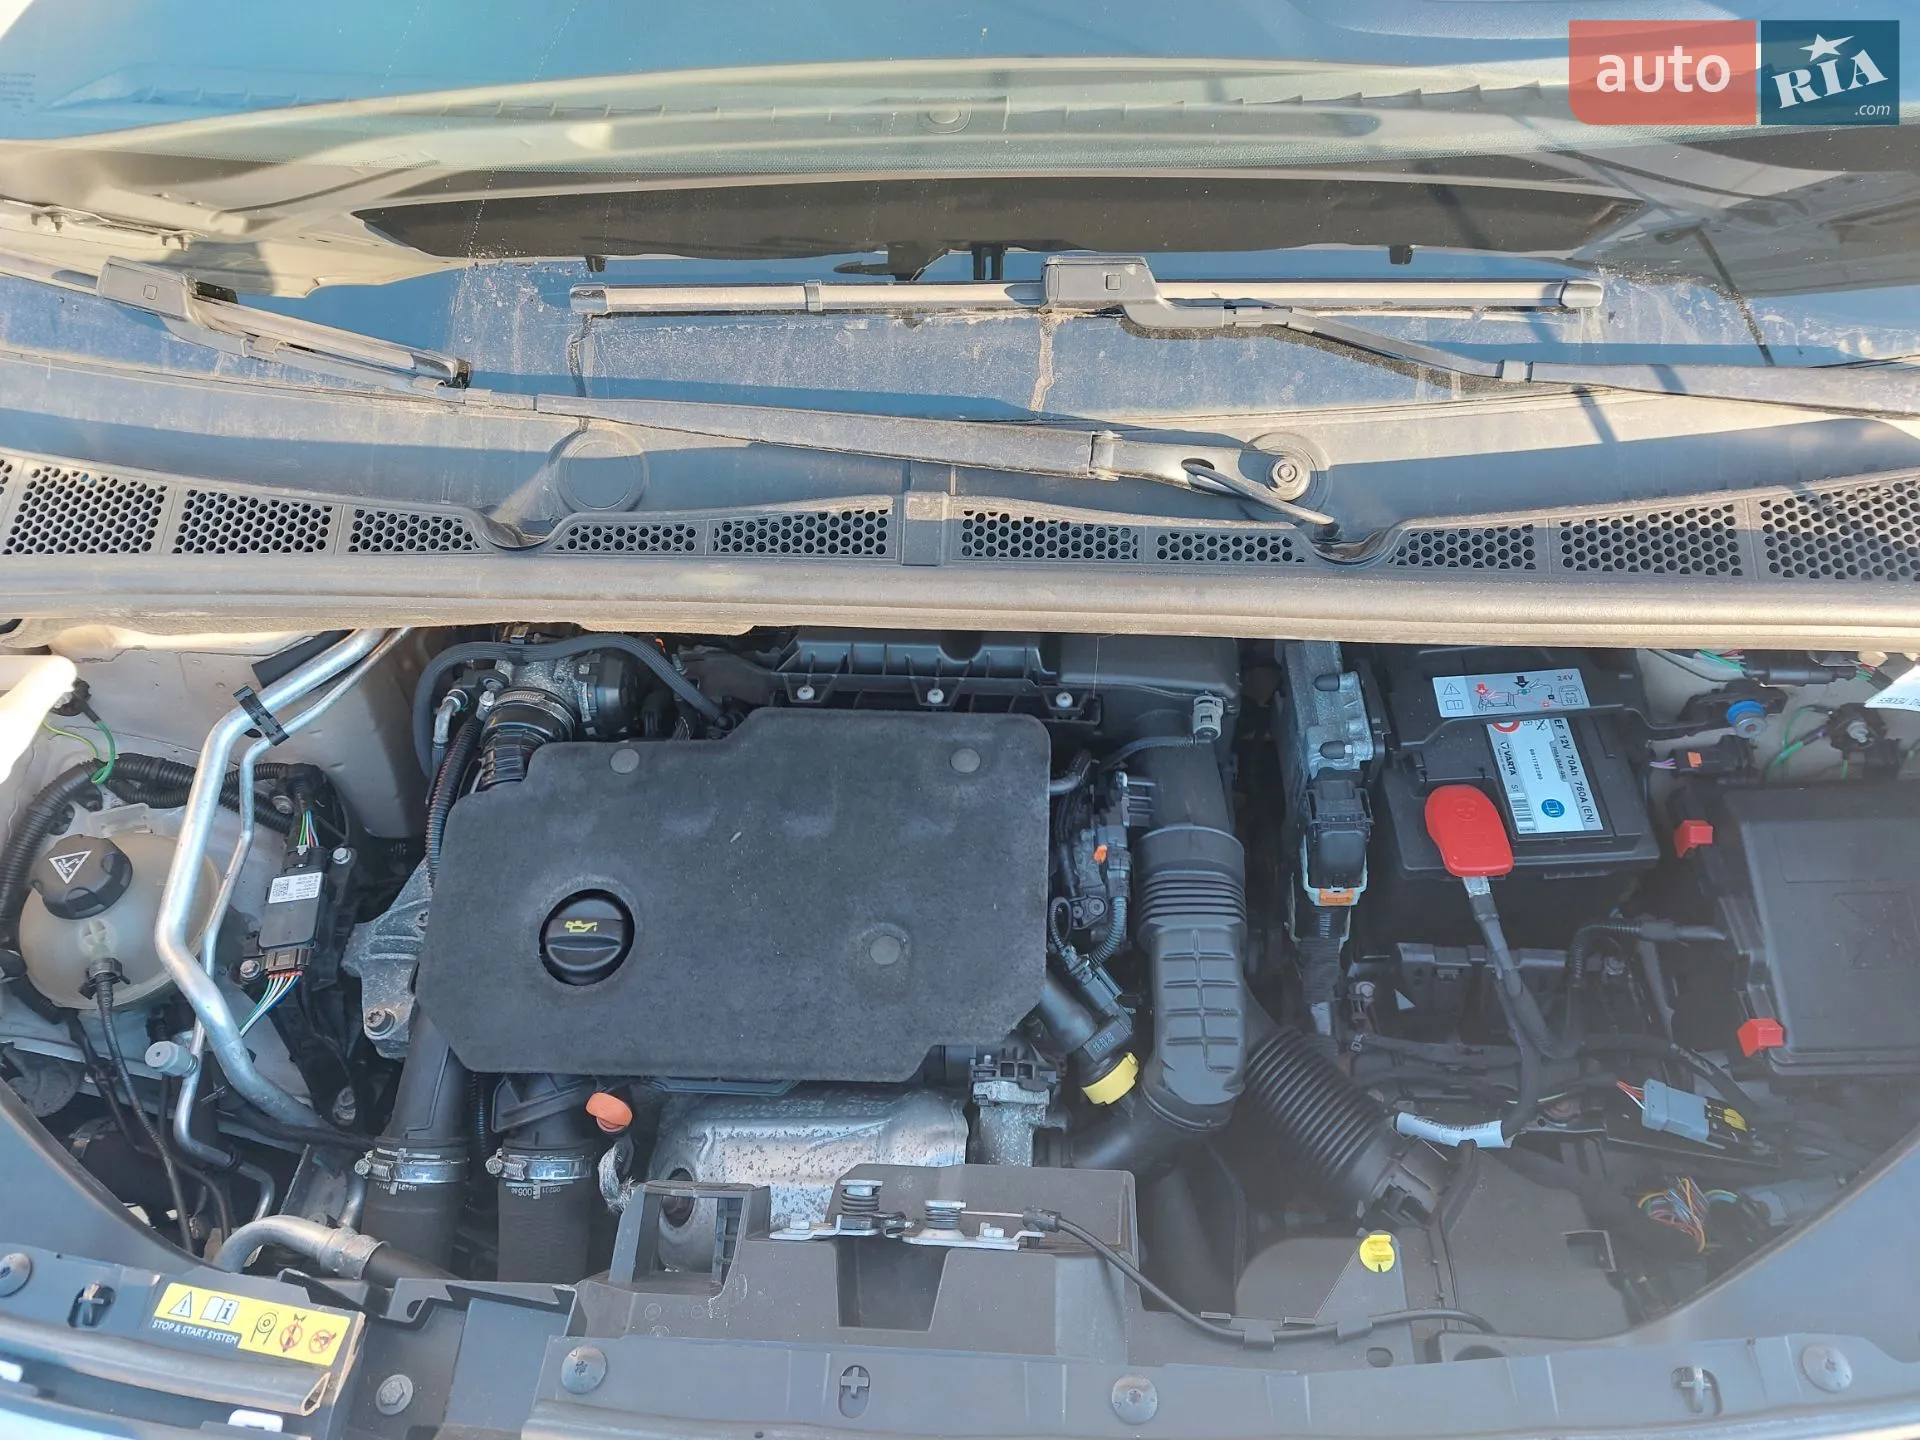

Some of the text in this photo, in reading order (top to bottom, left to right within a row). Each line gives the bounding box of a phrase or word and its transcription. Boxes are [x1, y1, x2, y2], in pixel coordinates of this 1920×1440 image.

[1557, 674, 1573, 682] 24V
[1503, 750, 1517, 776] VARTA
[1559, 735, 1572, 750] 12V
[1566, 755, 1580, 776] 70Ah
[1574, 781, 1588, 803] 760A
[1581, 805, 1595, 823] (EN)
[152, 1319, 239, 1345] STOP & START SYSTEM
